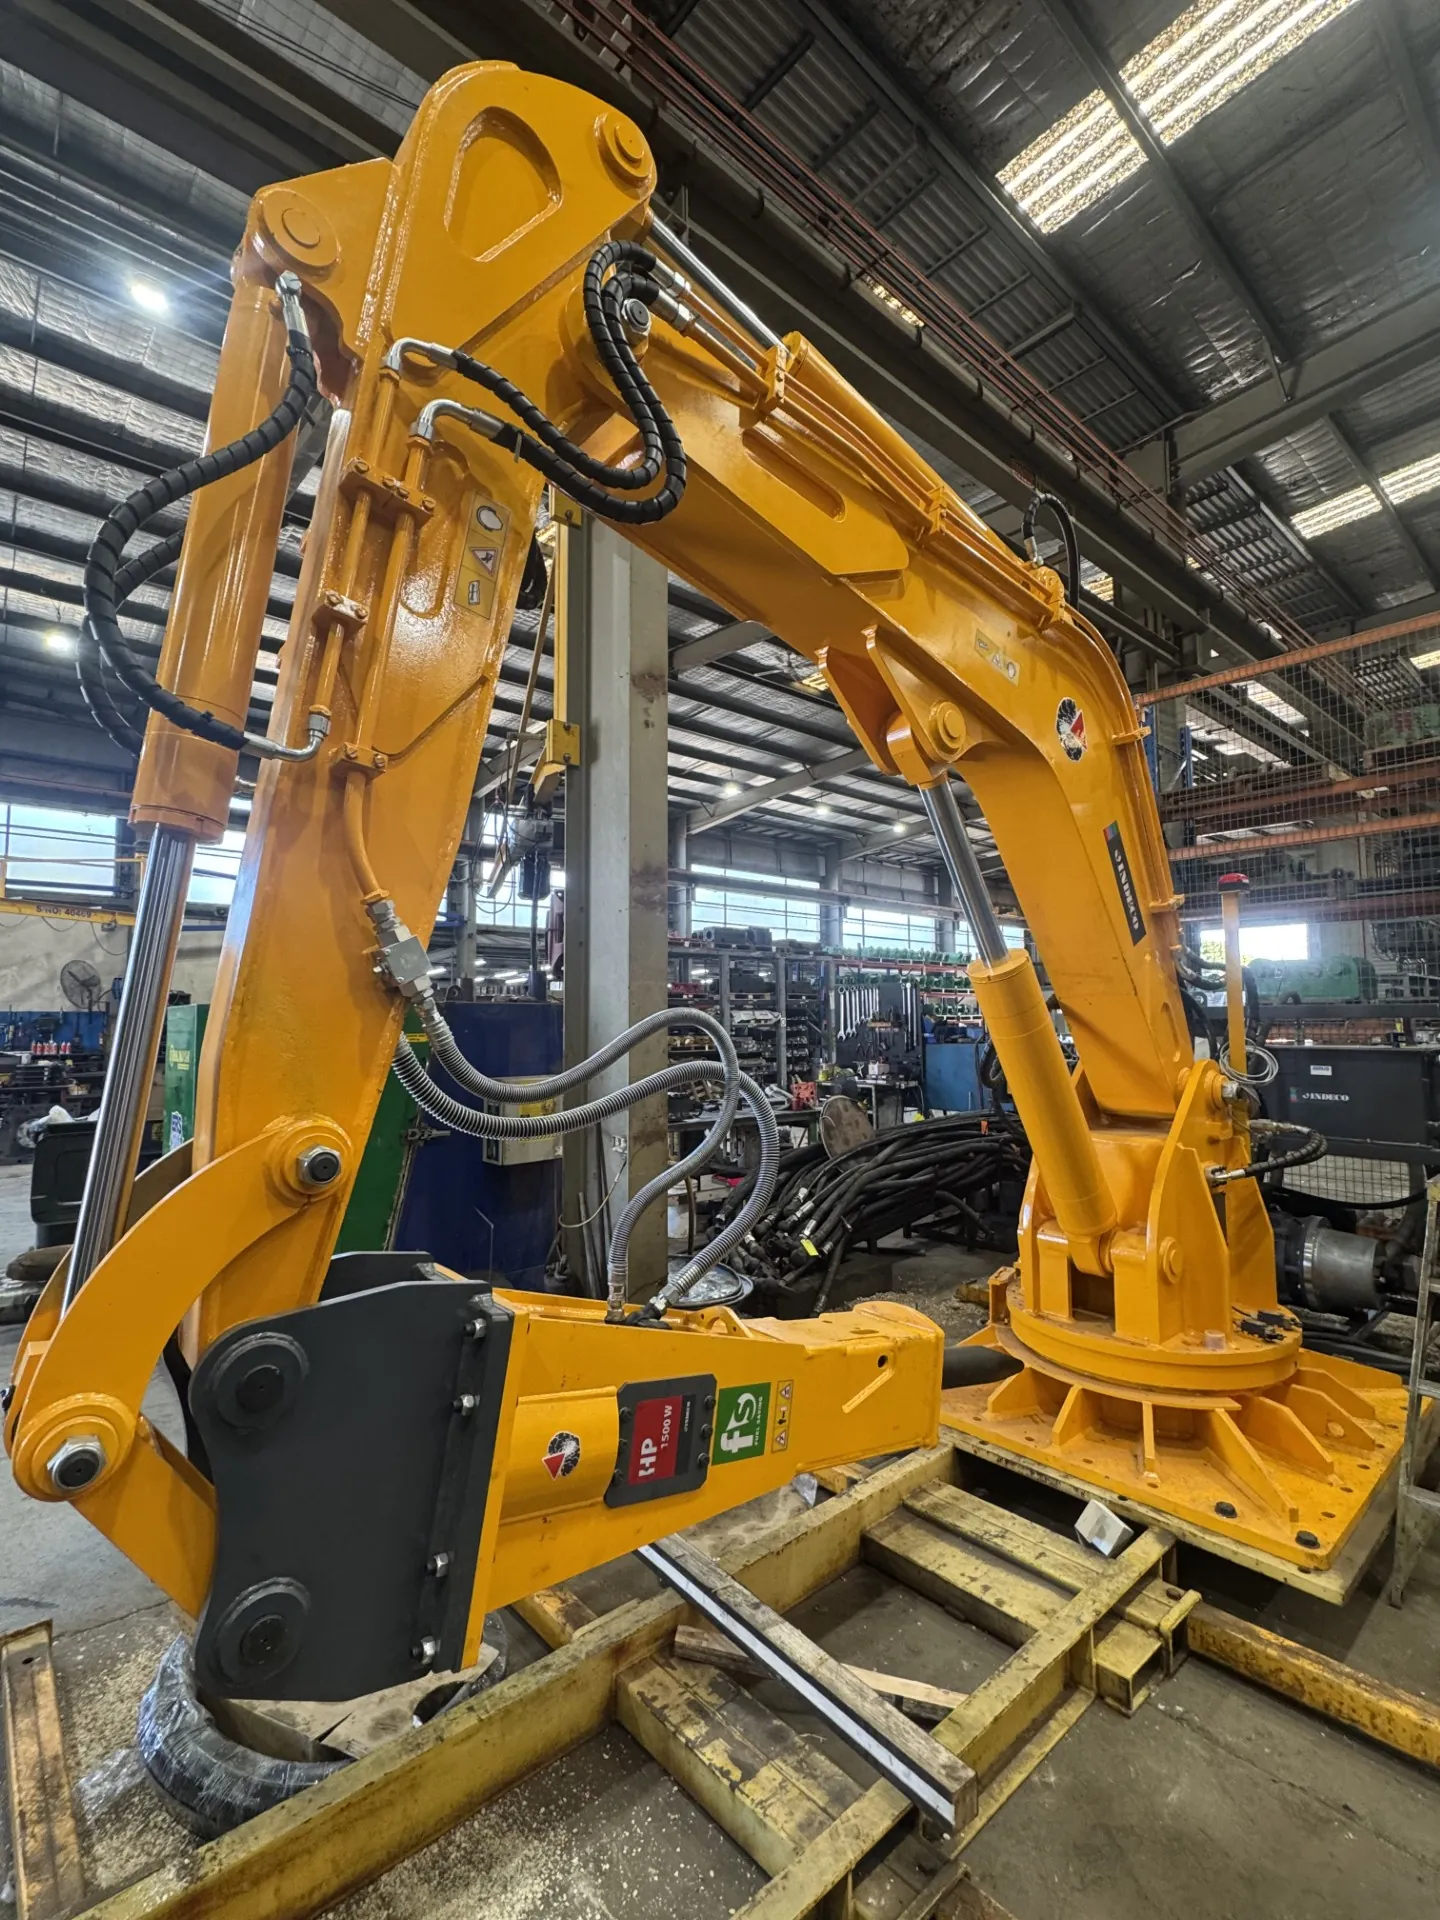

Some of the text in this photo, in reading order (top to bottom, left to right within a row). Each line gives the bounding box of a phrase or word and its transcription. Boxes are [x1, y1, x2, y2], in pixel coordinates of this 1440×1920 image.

[1118, 862, 1139, 930] INDECO
[1310, 1092, 1349, 1101] INDECO
[660, 1405, 673, 1449] 1500 W
[755, 1396, 763, 1424] SAVING
[638, 1438, 658, 1477] HP
